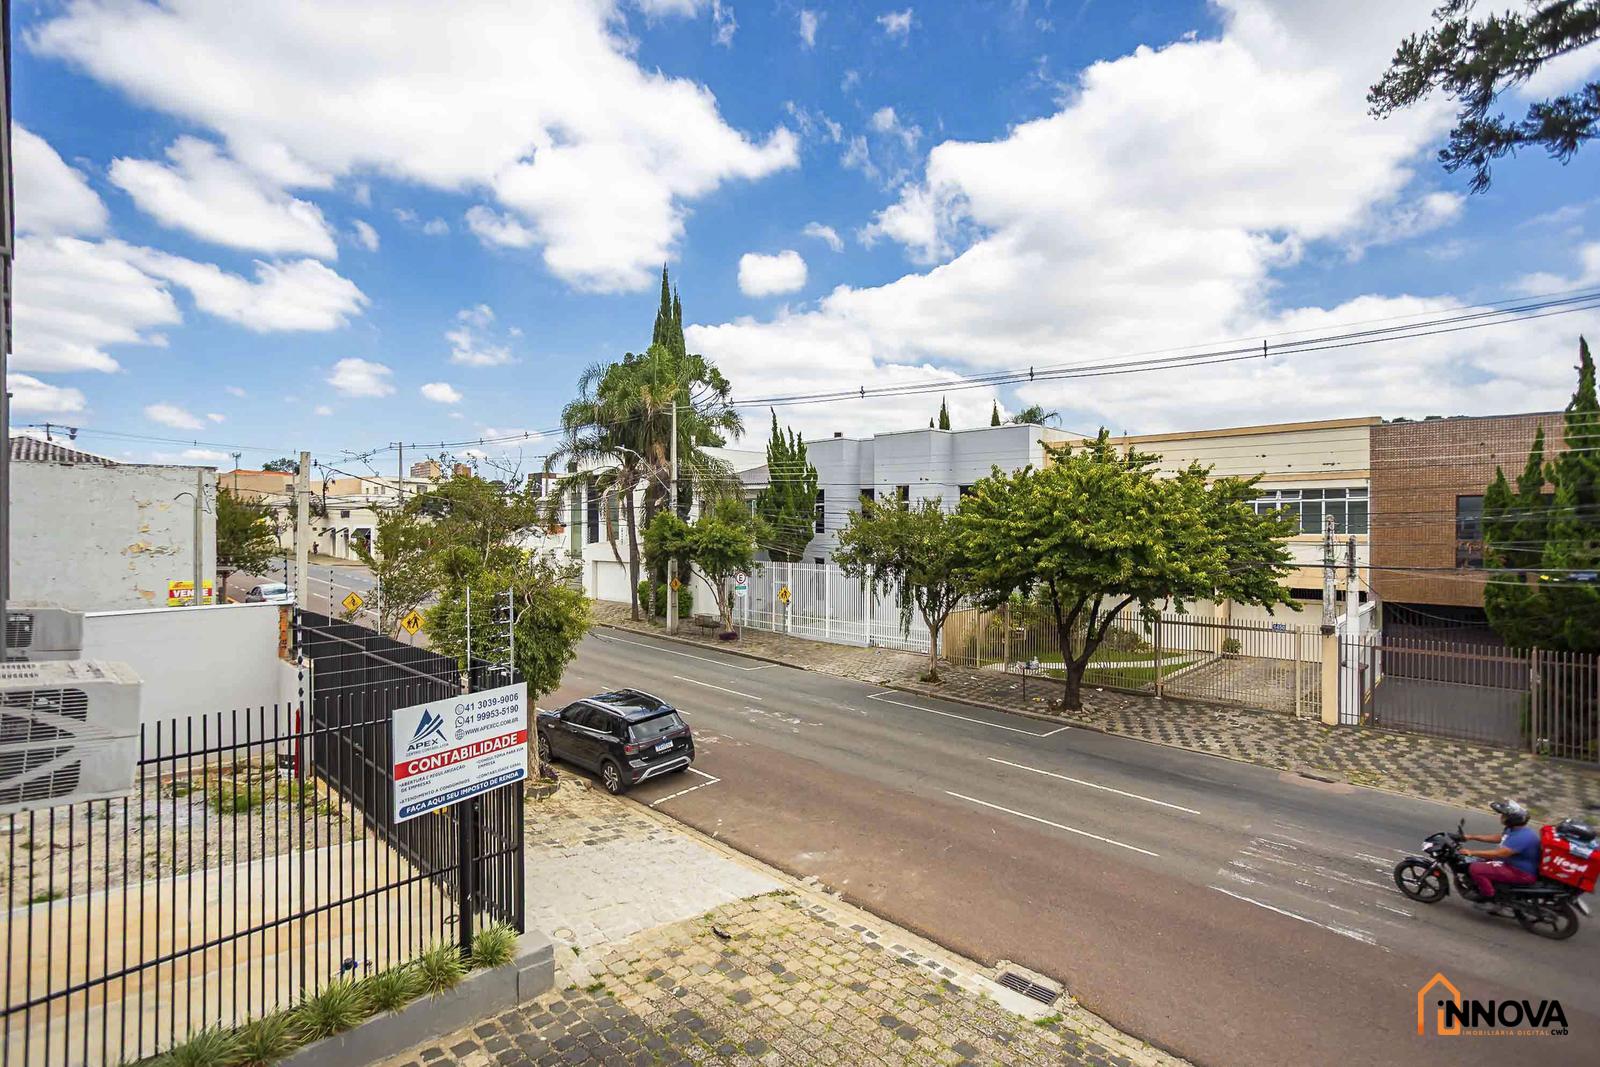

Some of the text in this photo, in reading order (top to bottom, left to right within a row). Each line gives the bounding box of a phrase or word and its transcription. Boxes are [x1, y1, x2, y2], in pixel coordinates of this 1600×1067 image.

[173, 588, 208, 598] VENE
[465, 692, 518, 712] 41 3039-9006
[465, 704, 518, 724] 41 99953-5190
[407, 738, 438, 752] APEX
[408, 732, 518, 774] CONTABILIDADE
[406, 771, 519, 814] FAÇA AQUI SEU IMPOSTO DE RENDA
